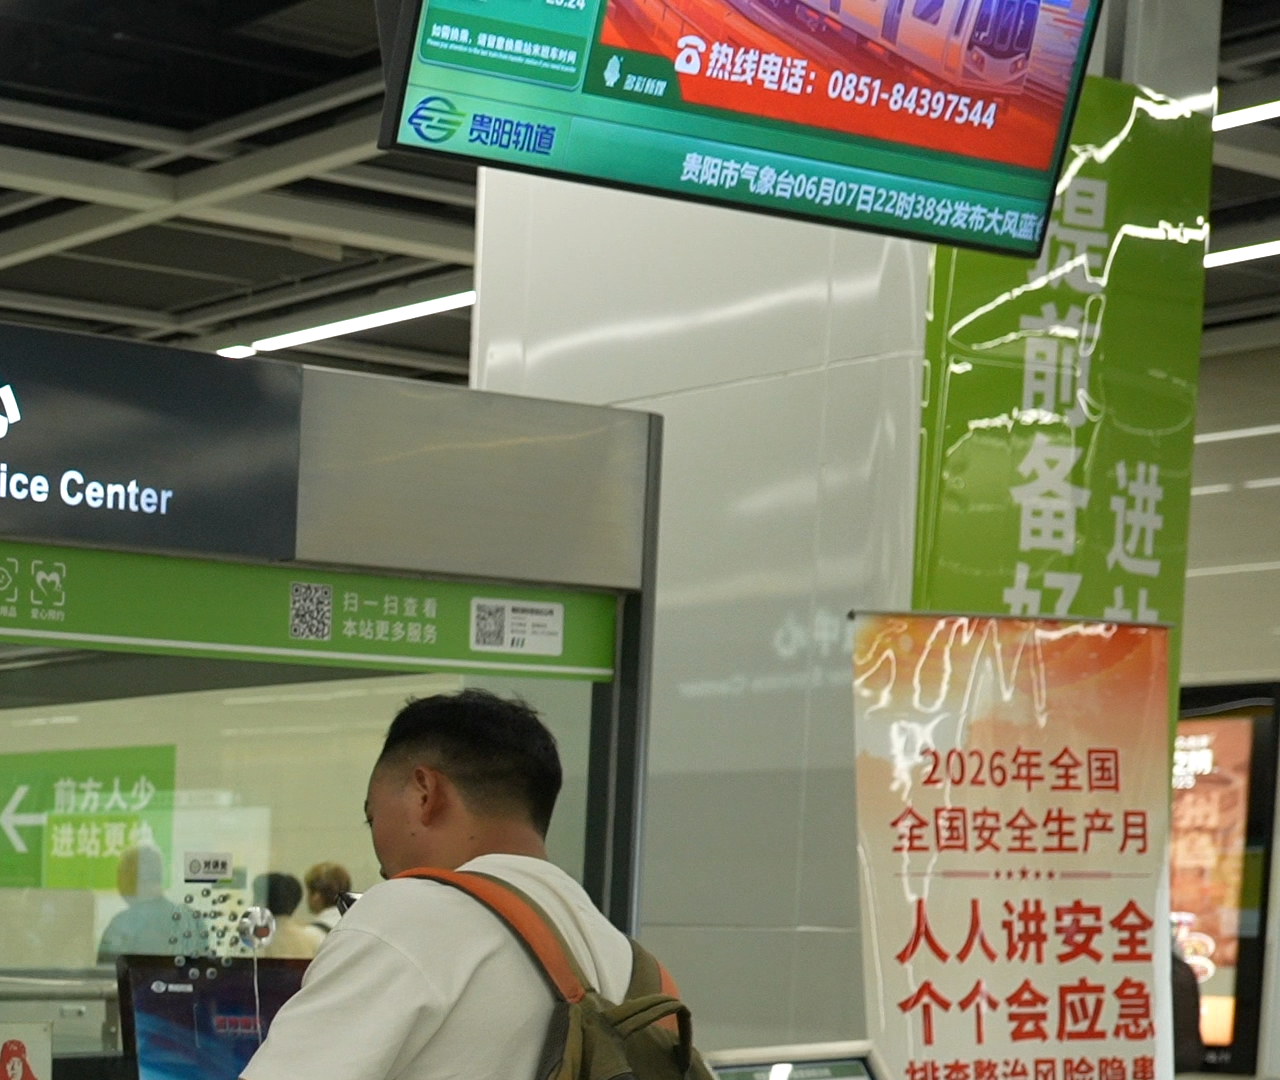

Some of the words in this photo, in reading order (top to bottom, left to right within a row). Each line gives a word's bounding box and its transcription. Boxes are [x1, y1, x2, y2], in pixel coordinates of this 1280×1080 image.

[827, 70, 998, 129] 0851-84397544
[468, 113, 556, 156] 贵阳轨道
[59, 470, 173, 515] Center
[342, 591, 438, 621] 扫一扫查看
[341, 619, 438, 645] 本站更多服务
[920, 744, 1121, 793] 2026年全国
[53, 775, 156, 815] 前方人少
[890, 805, 1150, 855] 全国安全生产月
[895, 898, 1154, 964] 人人讲安全
[898, 976, 1156, 1046] 个个会应急
